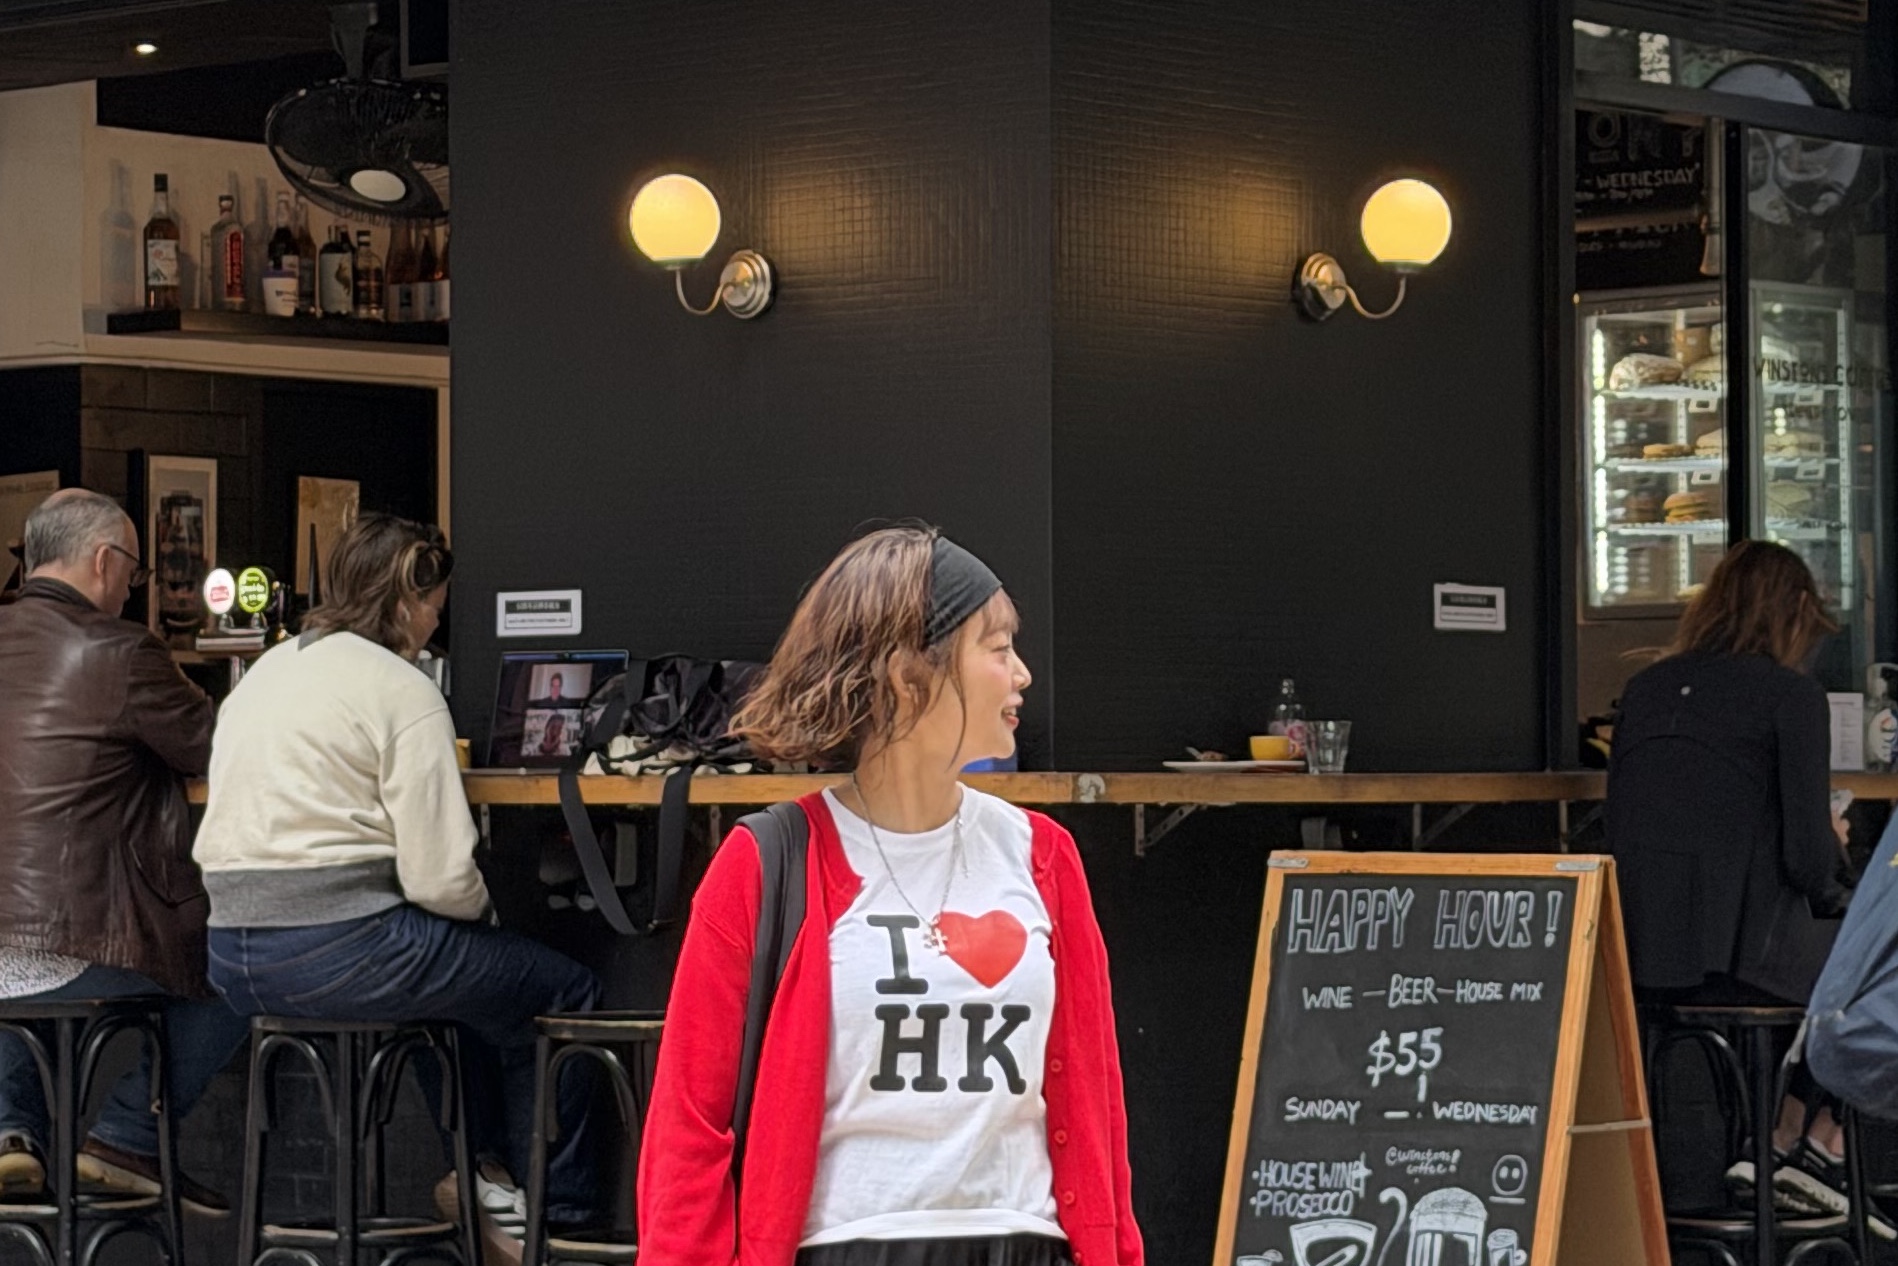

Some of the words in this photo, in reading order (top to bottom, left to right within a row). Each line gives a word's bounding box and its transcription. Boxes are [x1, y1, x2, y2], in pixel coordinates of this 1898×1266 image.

[1287, 886, 1414, 953] HAPPY
[866, 914, 929, 994] I
[1302, 986, 1352, 1010] WINE
[1388, 973, 1438, 1008] BEER
[1456, 979, 1504, 1003] HOUSE
[1509, 981, 1544, 1001] MIX
[870, 1003, 1031, 1094] HK
[1366, 1026, 1444, 1088] $55
[1284, 1096, 1361, 1125] SUNDAY
[1432, 1101, 1539, 1125] WEDNESDAY
[1258, 1159, 1317, 1191] HOUSE
[1255, 1190, 1355, 1219] PROSECCO
